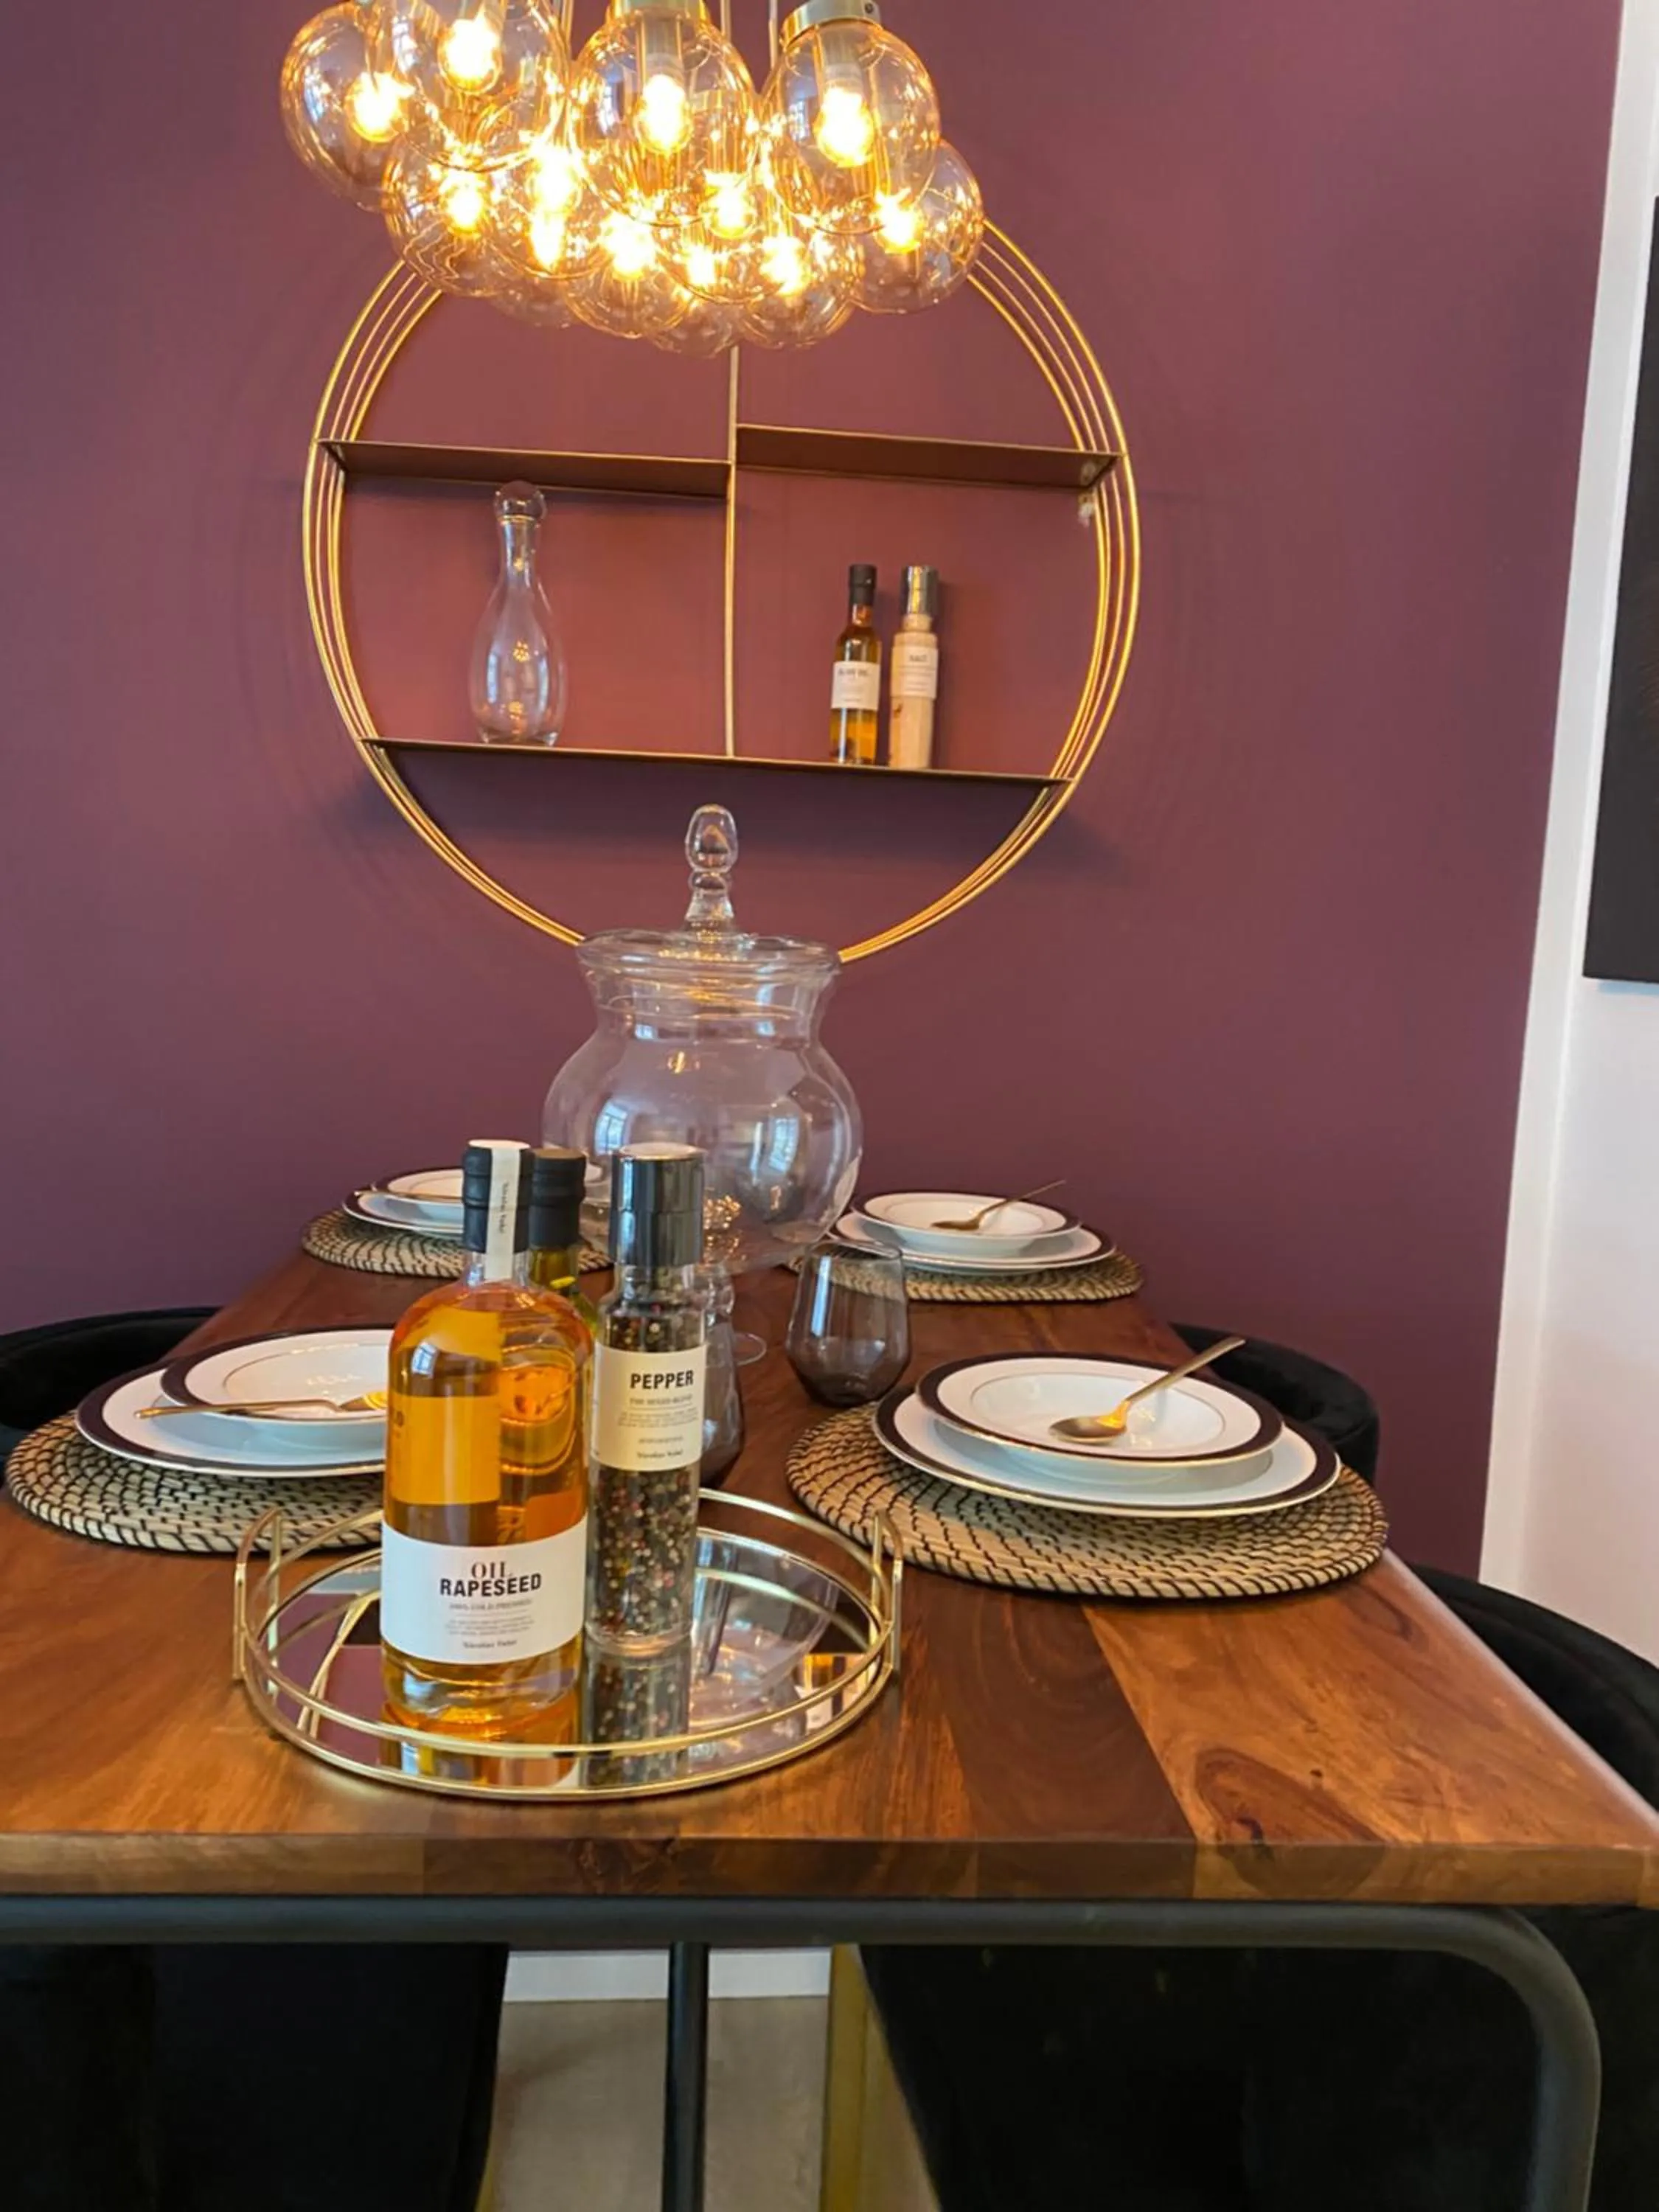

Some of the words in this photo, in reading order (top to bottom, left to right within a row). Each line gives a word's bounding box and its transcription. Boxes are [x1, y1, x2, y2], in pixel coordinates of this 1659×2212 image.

[630, 1370, 694, 1390] PEPPER
[470, 1561, 514, 1579] OIL
[439, 1573, 542, 1598] RAPESEED
